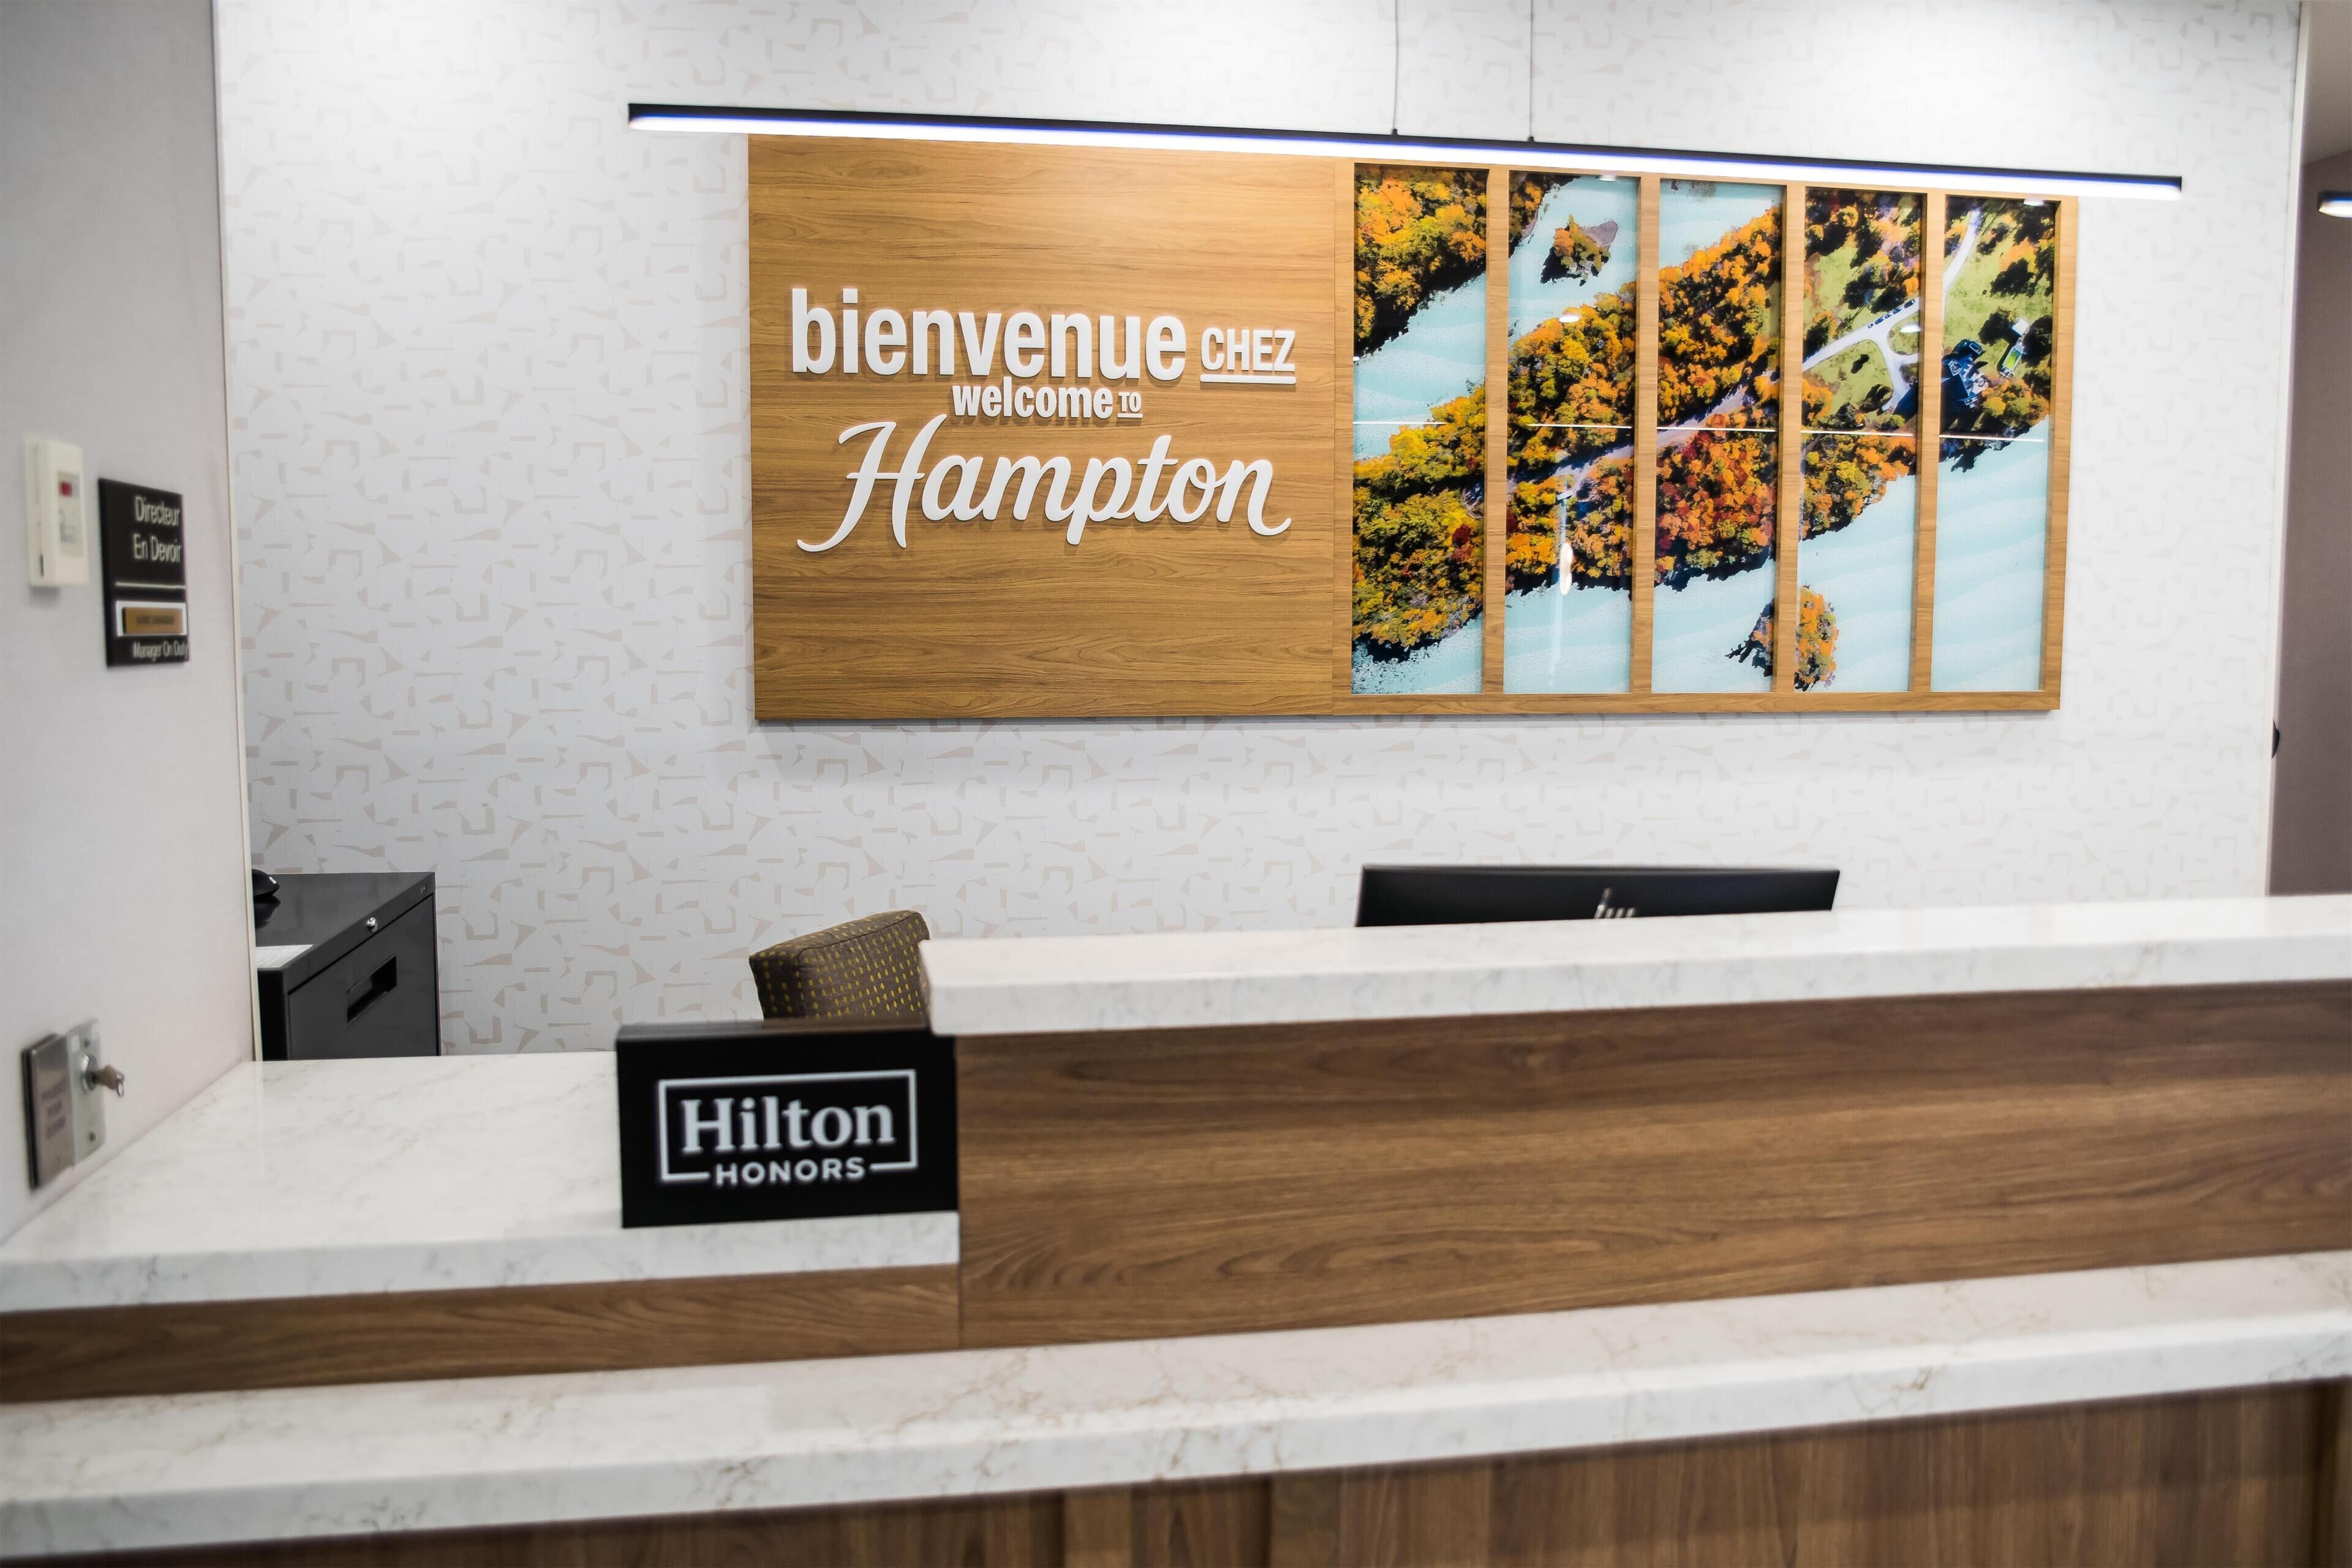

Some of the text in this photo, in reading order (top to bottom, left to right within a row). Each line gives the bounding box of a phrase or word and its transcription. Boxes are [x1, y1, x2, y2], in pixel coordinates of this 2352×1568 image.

[792, 288, 1295, 381] bienvenue CHEZ
[952, 376, 1142, 418] welcome TO
[797, 414, 1291, 552] Hampton
[135, 496, 180, 526] Directeur
[134, 533, 181, 562] En Devoir
[133, 641, 162, 662] Manager
[162, 641, 173, 657] On
[682, 1096, 896, 1154] Hilton
[715, 1156, 865, 1186] HONORS
